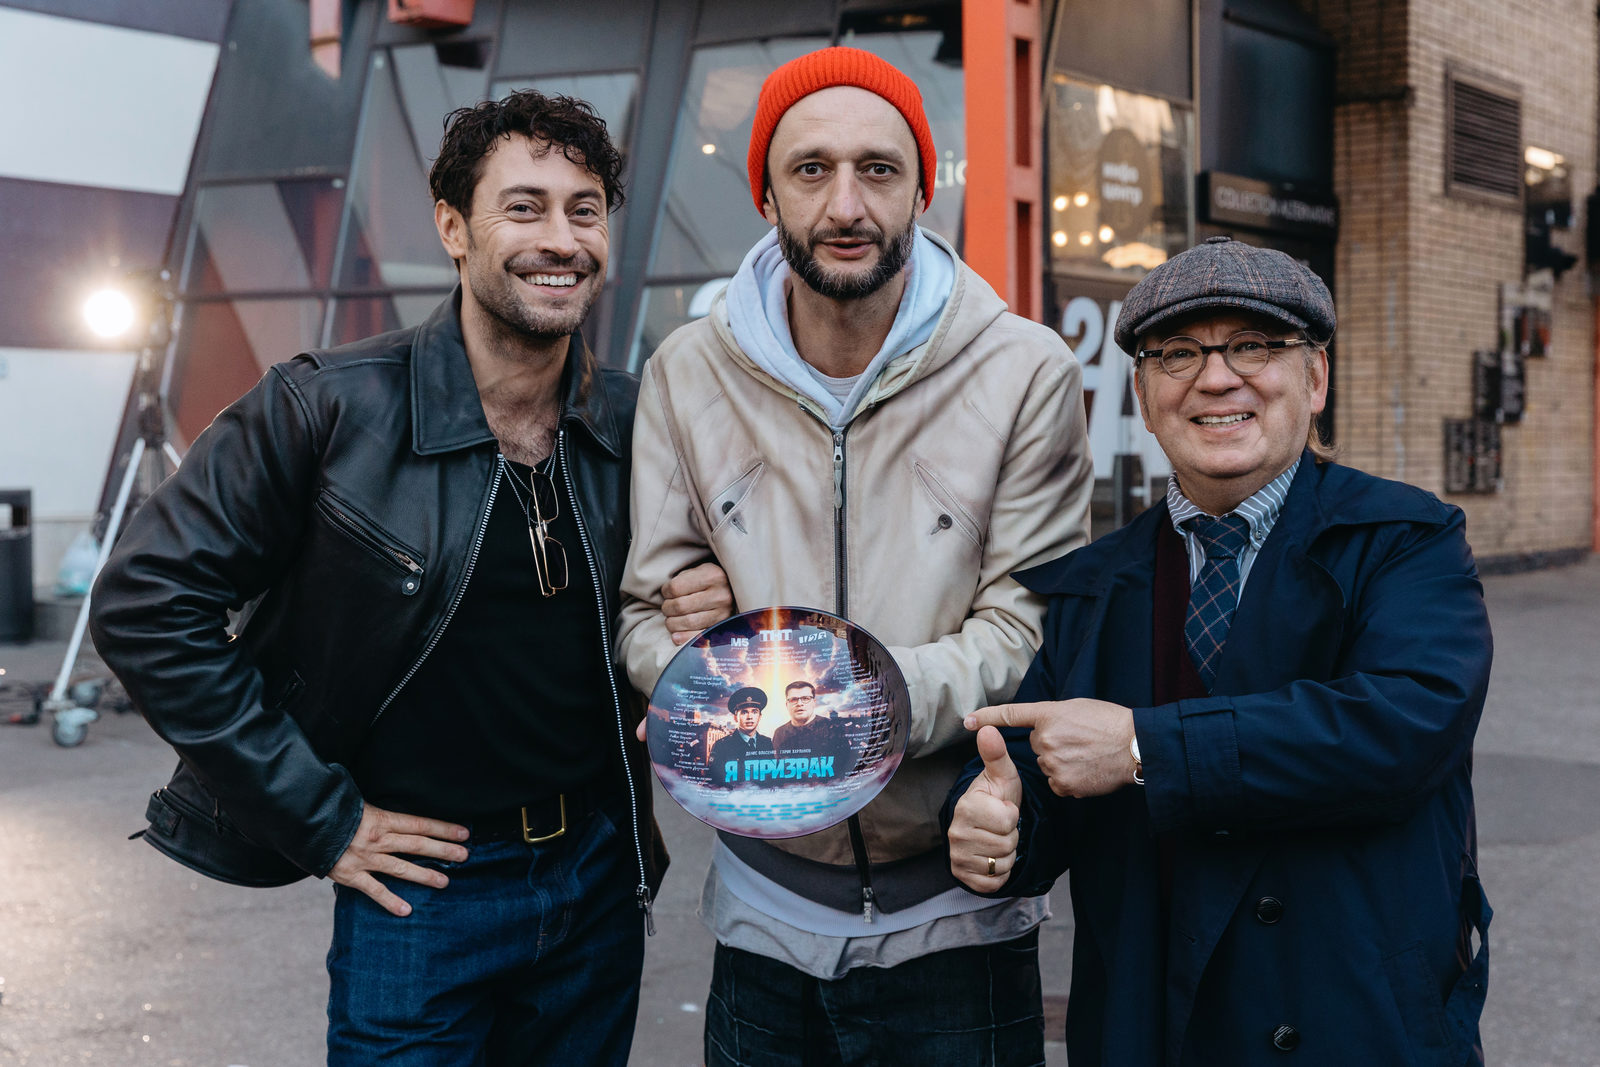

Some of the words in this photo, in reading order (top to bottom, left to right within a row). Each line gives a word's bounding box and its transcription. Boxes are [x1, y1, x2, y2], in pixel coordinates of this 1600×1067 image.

[759, 629, 793, 642] ТНТ
[724, 760, 738, 783] Я
[744, 755, 835, 781] ПРИЗРАК
